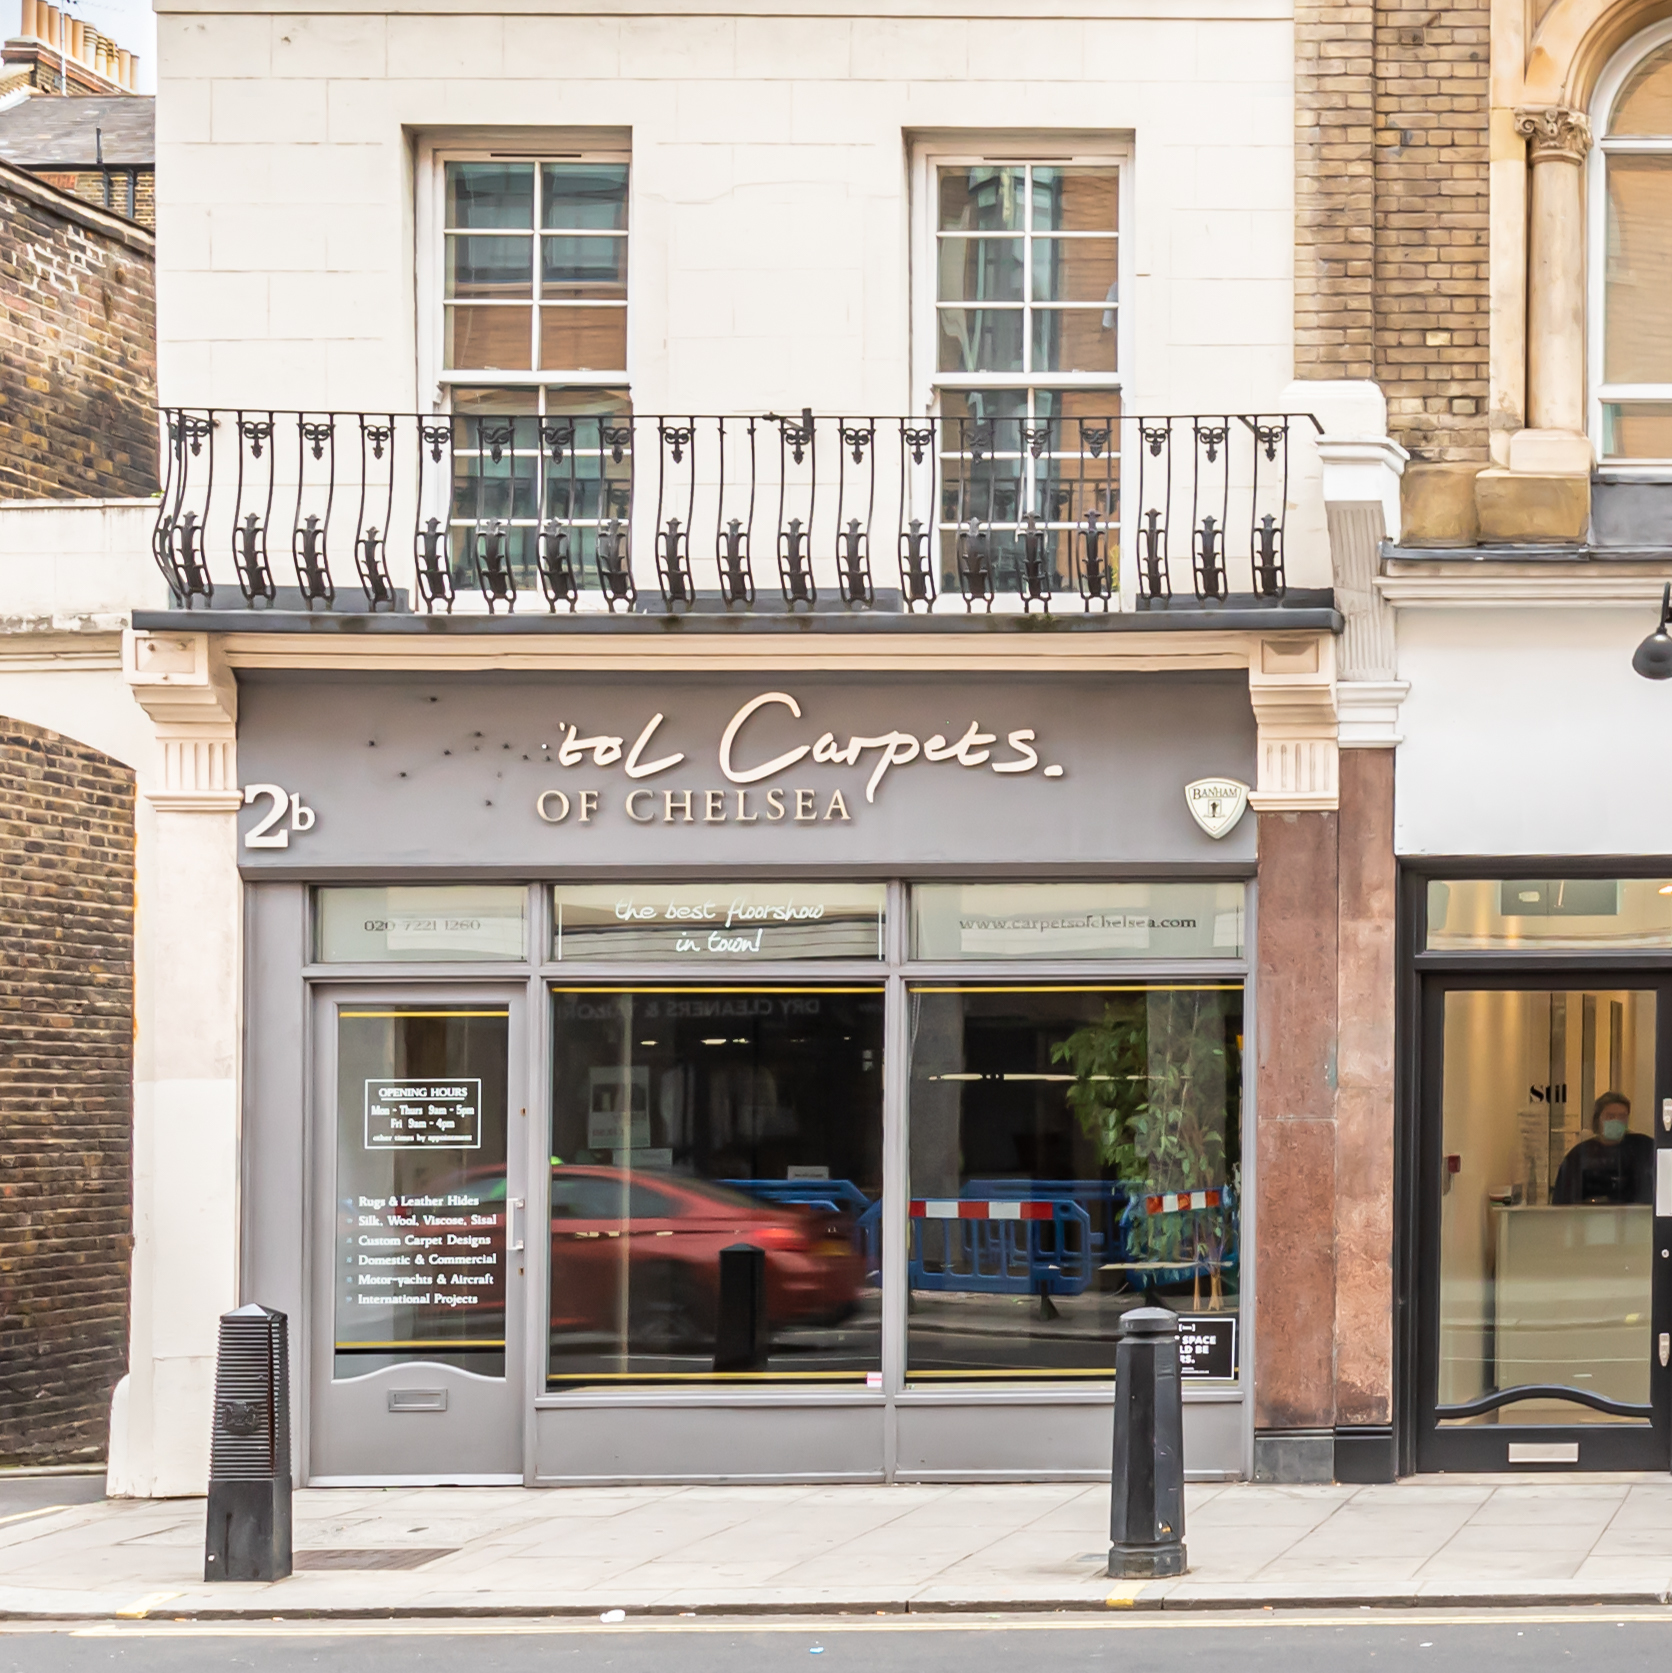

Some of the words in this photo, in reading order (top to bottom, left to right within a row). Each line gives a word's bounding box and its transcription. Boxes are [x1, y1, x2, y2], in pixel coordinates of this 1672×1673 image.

[1192, 787, 1238, 800] BANHAM
[536, 788, 600, 823] OF
[625, 788, 852, 822] CHELSEA
[615, 900, 657, 921] the
[664, 899, 717, 920] best
[725, 898, 825, 928] floorshow
[364, 920, 396, 932] 020
[404, 920, 437, 931] 7221
[444, 919, 481, 931] 1260
[959, 915, 1197, 932] www.carpetsofchelsea.com
[675, 932, 702, 953] in
[707, 928, 764, 953] town!
[378, 1087, 427, 1097] OPENING
[430, 1087, 468, 1097] HOURS
[1529, 1083, 1568, 1104] Stil
[371, 1105, 390, 1115] Mon
[399, 1105, 423, 1115] Thurs
[428, 1104, 447, 1115] 9am
[456, 1104, 475, 1118] 5pm
[390, 1118, 403, 1128] Fri
[408, 1118, 427, 1129] 9am
[436, 1118, 455, 1131] 4pm
[358, 1196, 385, 1210] Rugs
[389, 1196, 398, 1207] &
[401, 1195, 444, 1207] Leather
[447, 1195, 480, 1207] Hides
[470, 1214, 497, 1226] Sisal
[358, 1235, 401, 1247] Custom
[404, 1235, 443, 1248] Carpet
[446, 1234, 491, 1248] Designs
[358, 1254, 410, 1266] Domestic
[414, 1254, 425, 1265] &
[428, 1253, 497, 1265] Commercial
[358, 1274, 433, 1287] Motor-yachts
[436, 1274, 447, 1285] &
[450, 1274, 494, 1285] Aircraft
[358, 1293, 430, 1305] International
[433, 1293, 478, 1307] Projects
[1182, 1335, 1216, 1345] SPACE
[1195, 1345, 1209, 1354] BE
